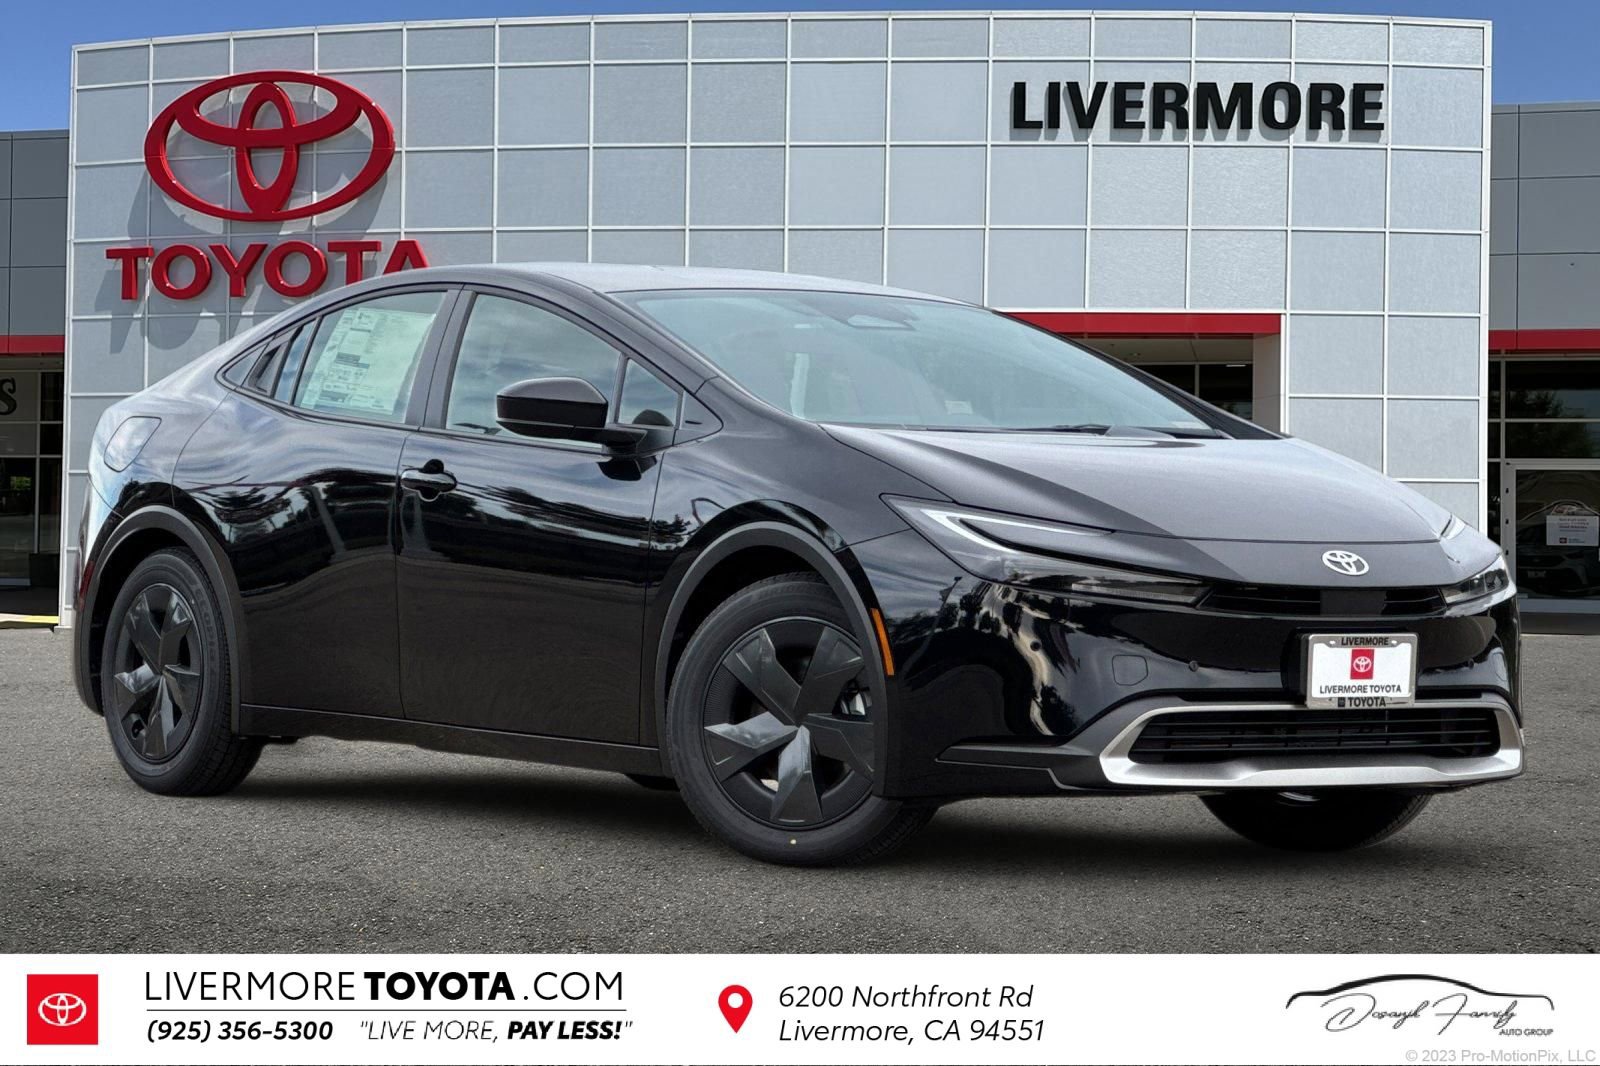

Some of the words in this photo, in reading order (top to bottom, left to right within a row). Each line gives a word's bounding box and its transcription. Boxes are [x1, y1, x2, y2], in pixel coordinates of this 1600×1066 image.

[1012, 81, 1385, 131] LIVERMORE
[105, 239, 428, 300] TOYOTA
[1341, 637, 1389, 646] LIVERMORE
[1319, 685, 1368, 694] LIVERMORE
[1370, 684, 1402, 693] TOYOTA
[1348, 697, 1387, 708] TOYOTA
